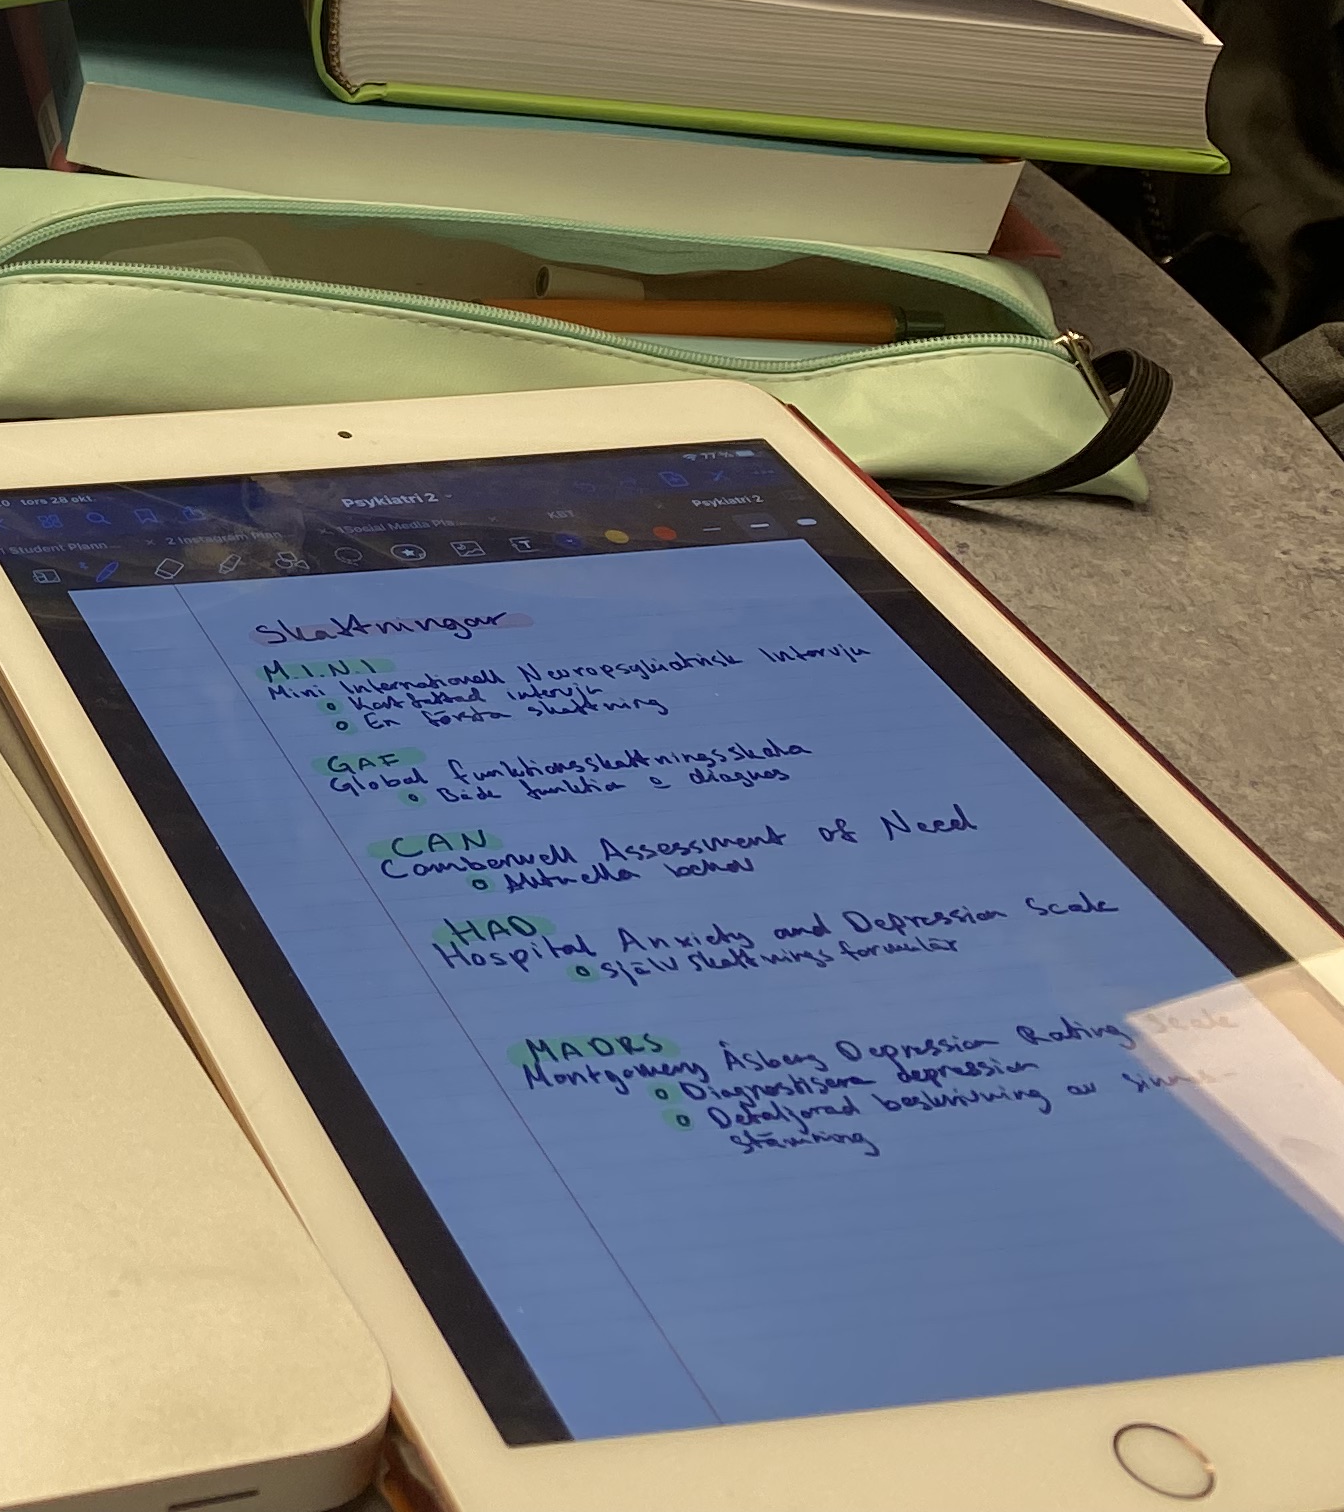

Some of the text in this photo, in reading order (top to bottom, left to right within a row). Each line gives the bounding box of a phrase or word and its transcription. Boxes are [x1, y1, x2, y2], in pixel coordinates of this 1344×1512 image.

[342, 492, 438, 508] Psykiatri 2
[692, 495, 750, 507] Psykiatri
[10, 544, 65, 555] Student
[268, 685, 326, 701] Mini
[364, 713, 400, 730] En
[327, 753, 399, 774] GAF
[330, 768, 428, 796] Global
[819, 818, 857, 843] of
[880, 804, 978, 841] Need
[391, 830, 486, 857] CAN
[432, 934, 597, 972] Hospital
[774, 912, 832, 939] and
[843, 906, 1008, 937] Depression
[1025, 891, 1118, 916] Scale
[443, 915, 537, 946] HAD
[525, 1033, 662, 1063] MADRS
